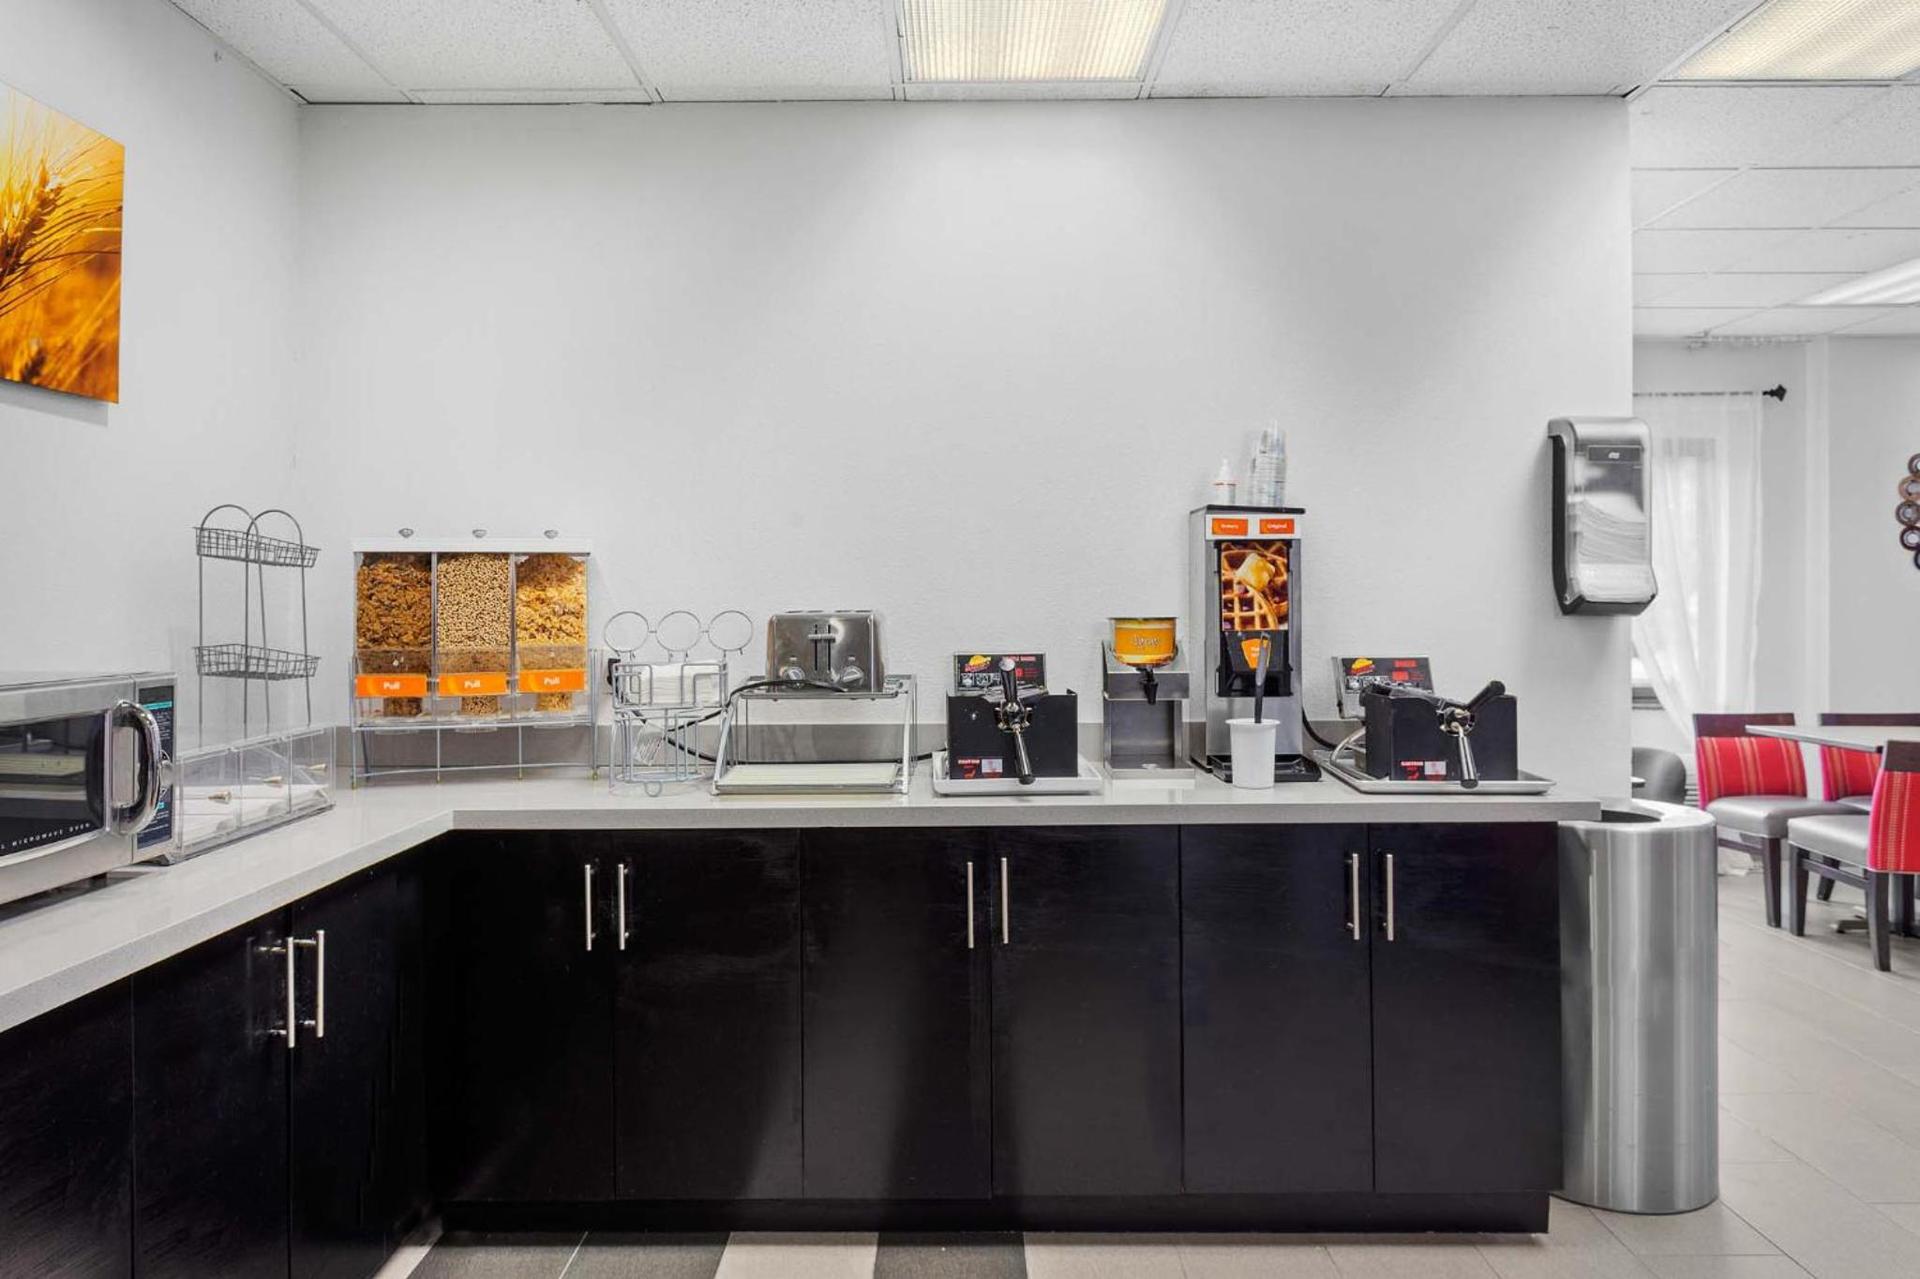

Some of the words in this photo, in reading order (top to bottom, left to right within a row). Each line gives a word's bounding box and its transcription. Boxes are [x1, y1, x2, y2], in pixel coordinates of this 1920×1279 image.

[383, 681, 400, 690] Pull
[464, 680, 481, 689] Pull
[543, 677, 560, 686] Pull
[12, 828, 63, 847] MICROWAVE
[69, 822, 90, 833] OVEN
